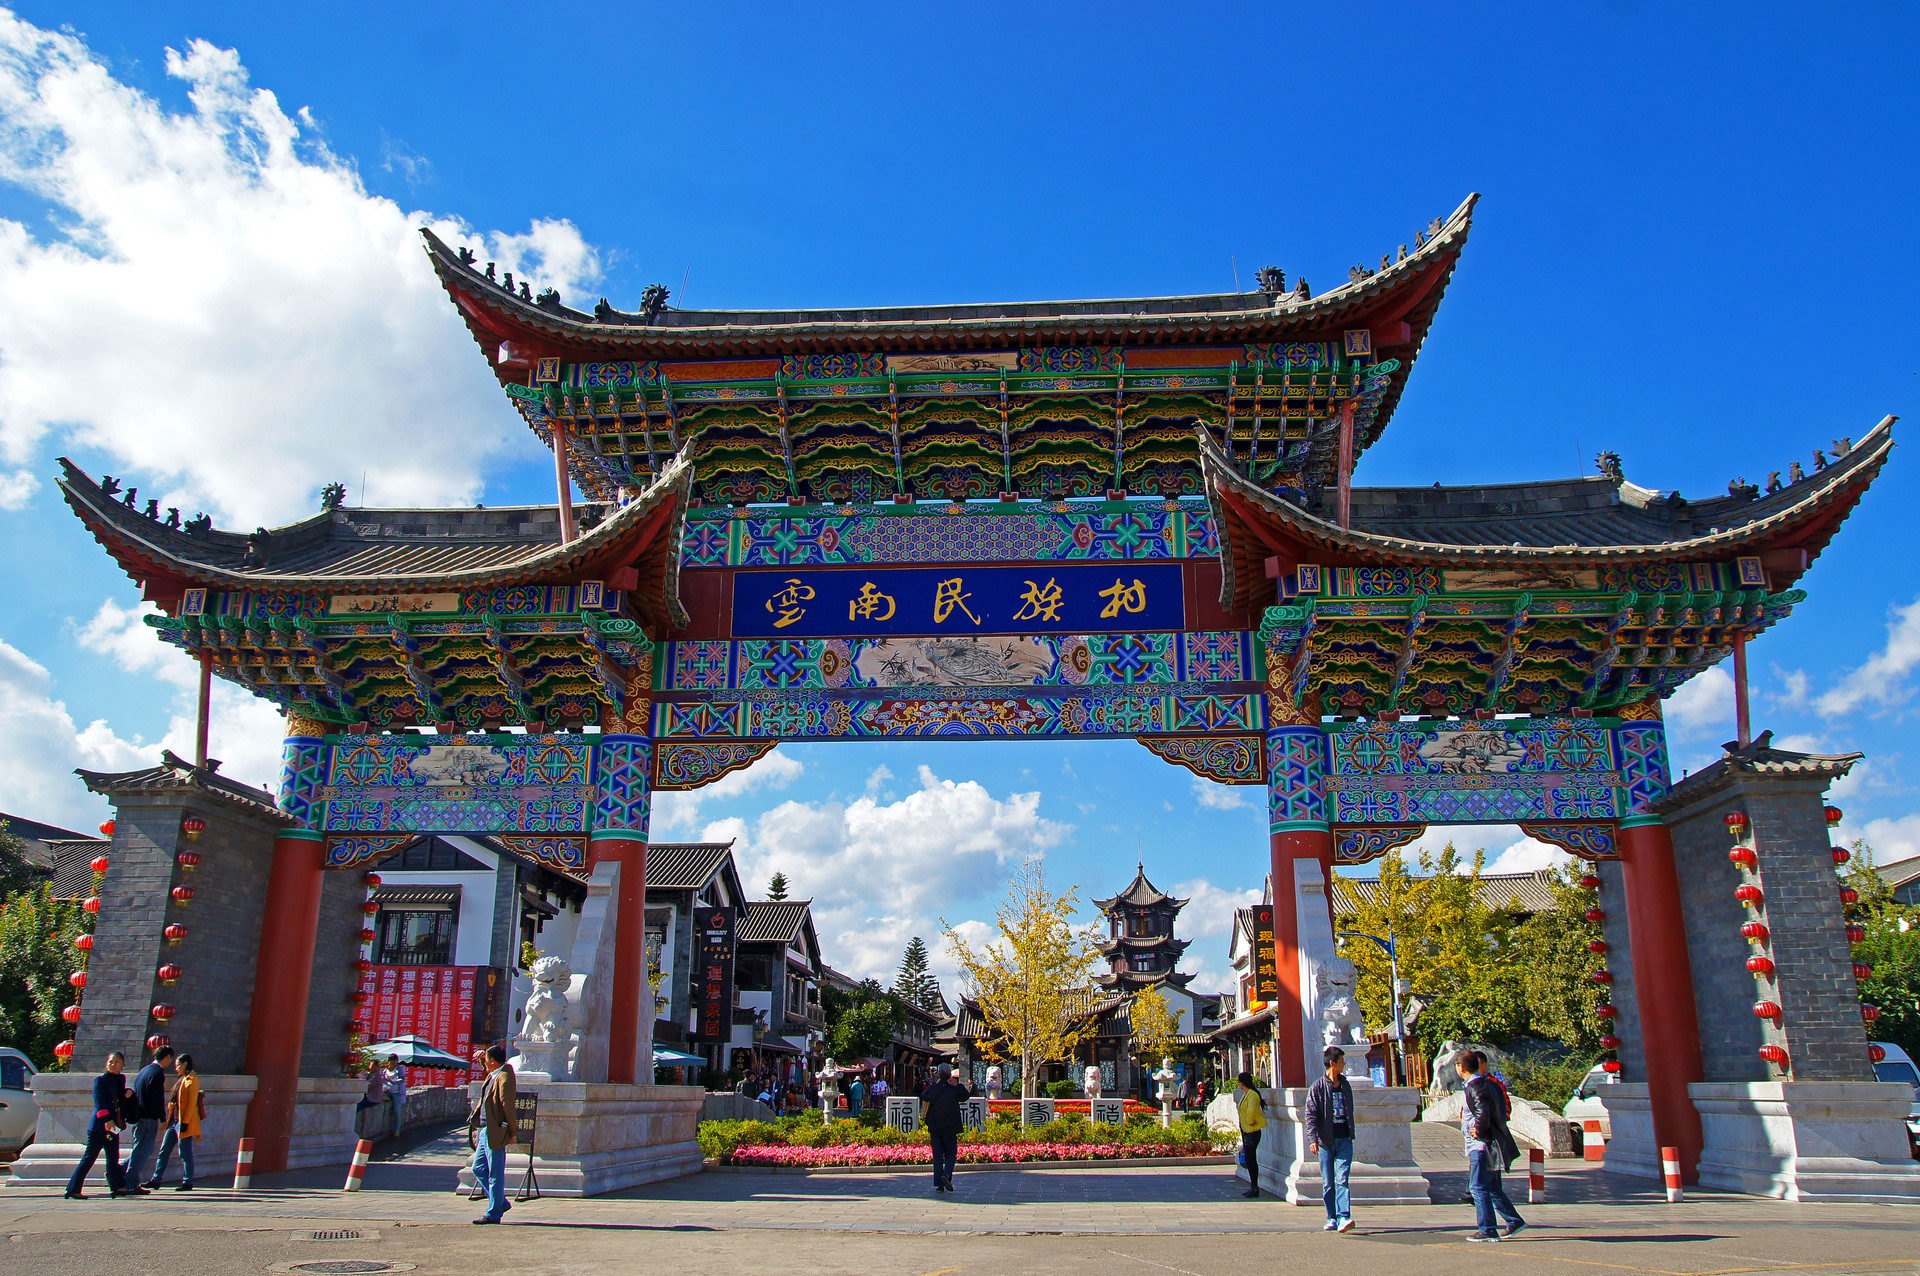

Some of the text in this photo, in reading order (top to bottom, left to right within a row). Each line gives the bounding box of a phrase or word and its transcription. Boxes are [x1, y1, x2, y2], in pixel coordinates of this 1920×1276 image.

[766, 577, 1147, 628] 雲南民族村
[1258, 931, 1277, 992] 翠福珠宝
[376, 969, 397, 1045] 热烈祝贺理想集团
[458, 971, 474, 1021] 一碗盛天下
[705, 965, 723, 1036] 理想家园
[516, 1119, 535, 1130] 者罚款
